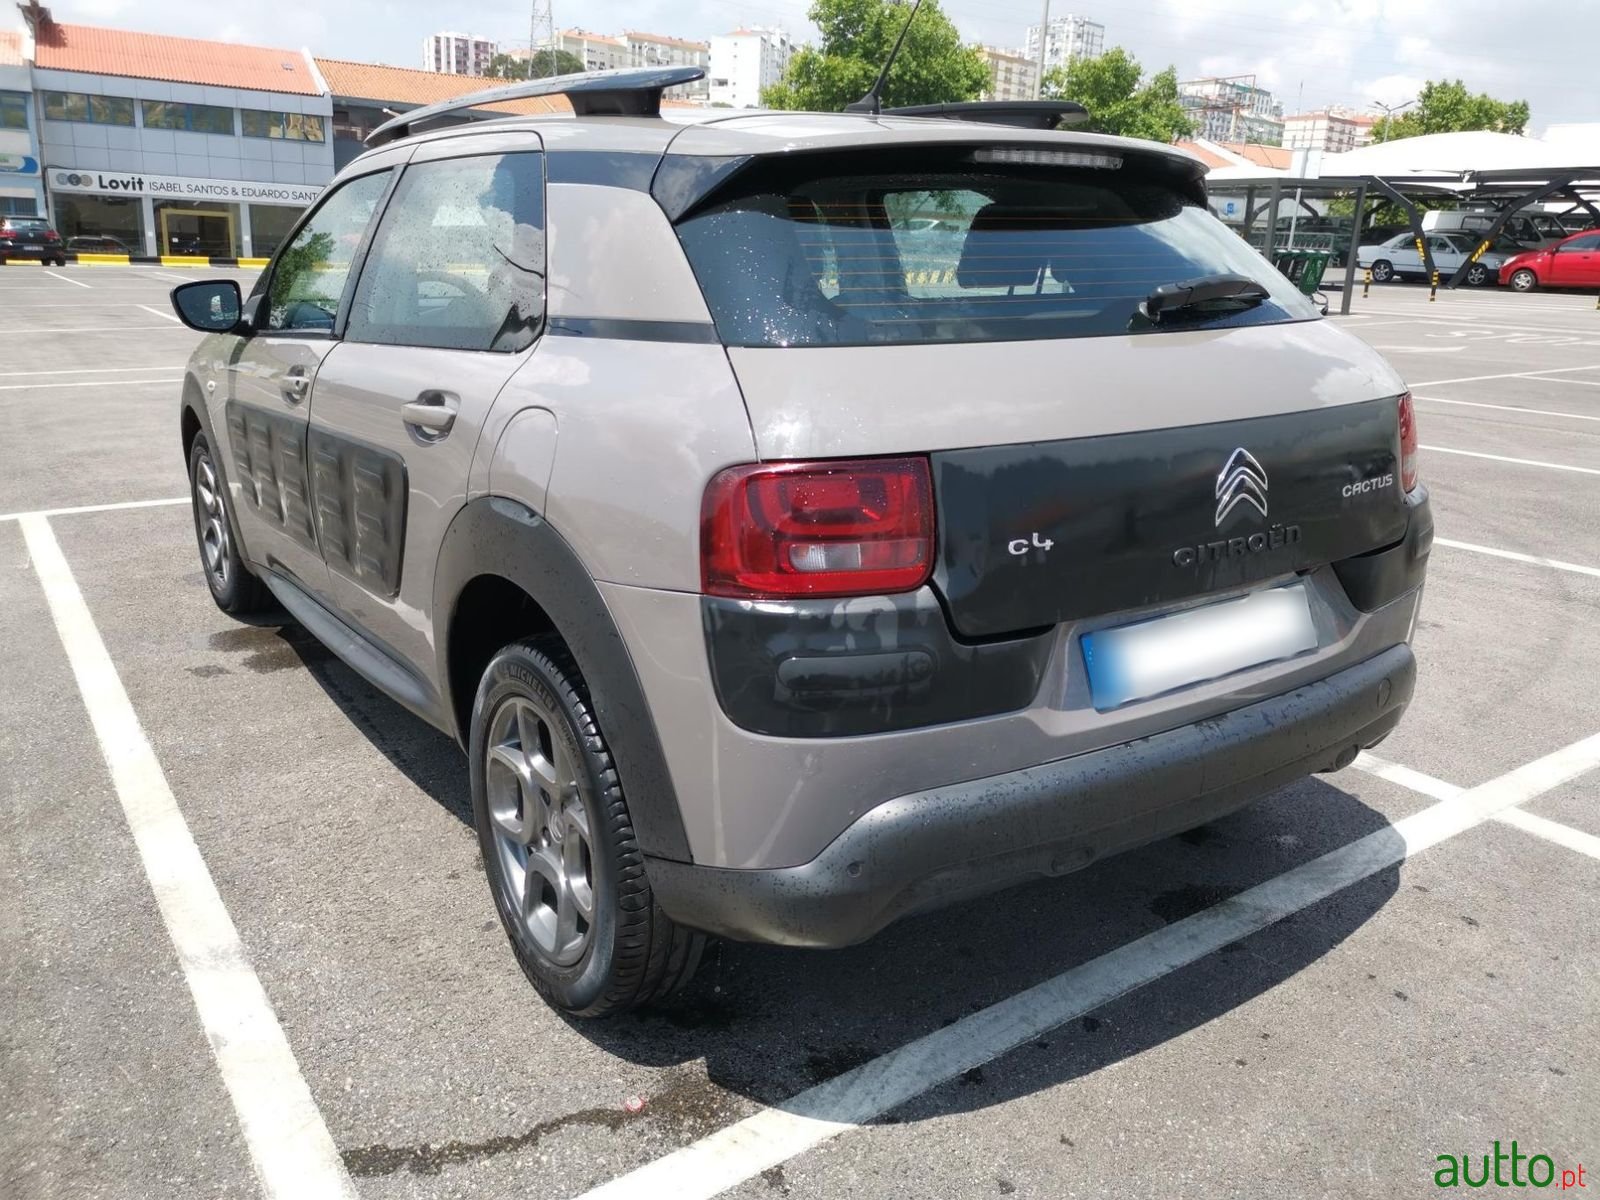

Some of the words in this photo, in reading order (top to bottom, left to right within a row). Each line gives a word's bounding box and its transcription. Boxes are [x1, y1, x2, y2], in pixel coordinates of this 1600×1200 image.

[98, 174, 144, 191] Lovit
[149, 181, 184, 193] ISABEL
[186, 183, 229, 195] SANTOS
[231, 186, 239, 196] &
[241, 187, 290, 199] EDUARDO
[292, 190, 319, 201] SANT
[1342, 473, 1393, 498] CACTUS
